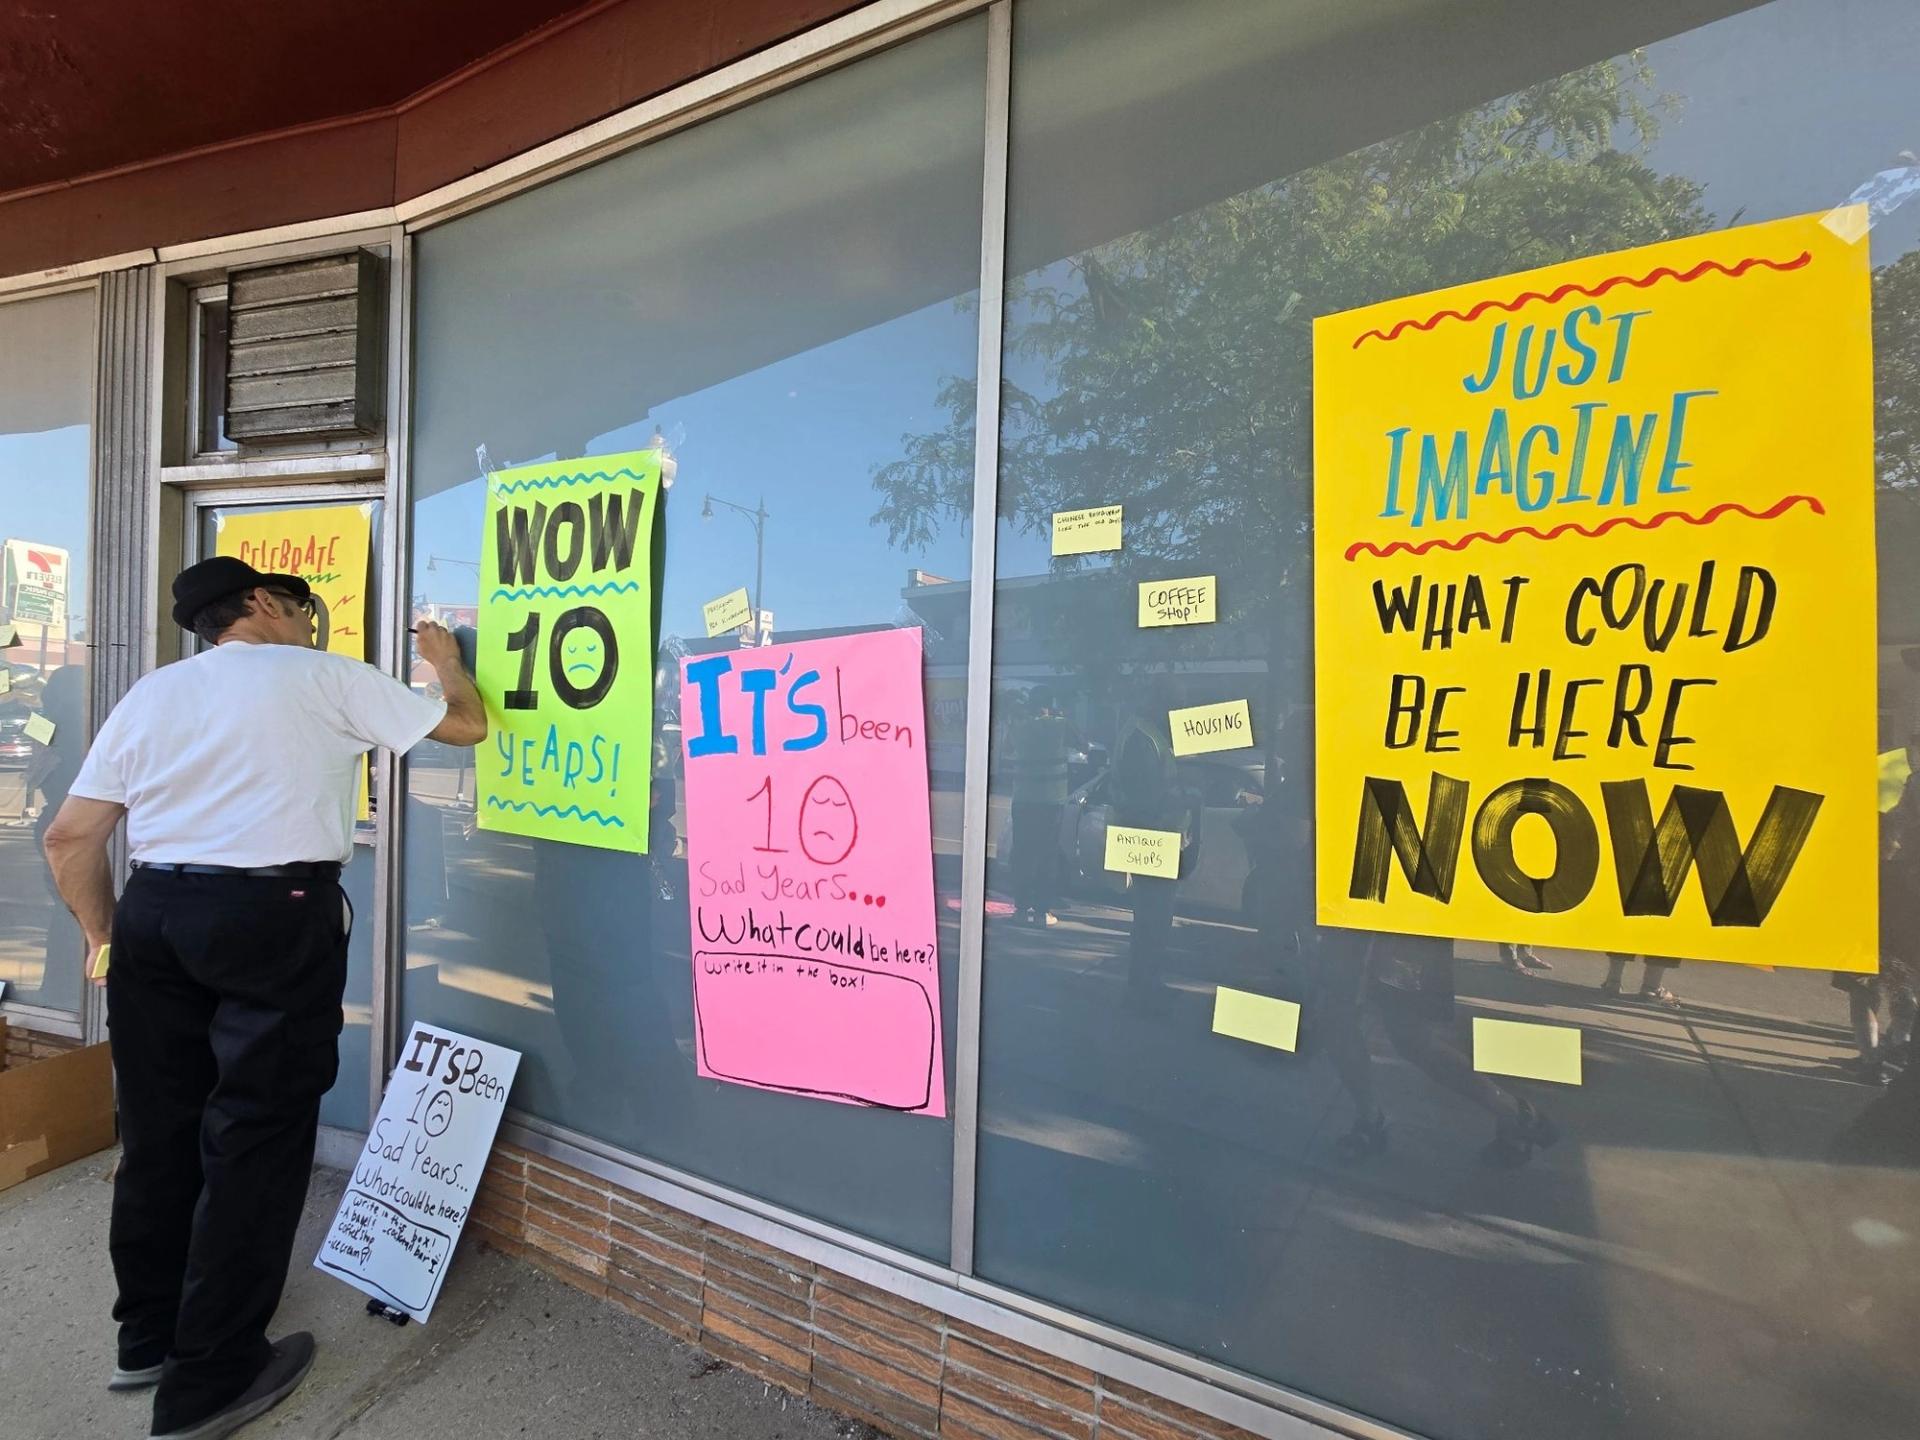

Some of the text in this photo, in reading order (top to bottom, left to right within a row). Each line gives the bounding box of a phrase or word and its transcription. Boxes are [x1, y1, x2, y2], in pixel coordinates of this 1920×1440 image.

[1462, 305, 1652, 400] JUST
[1378, 390, 1719, 528] IMAGINE
[240, 535, 340, 574] CELEBRATE
[496, 488, 645, 587] WOW
[1148, 586, 1207, 607] COFFEE
[1157, 606, 1199, 621] SHOP!
[1372, 559, 1777, 652] WHAT COULD
[504, 606, 619, 711] 10
[686, 652, 912, 759] IT'S been
[1184, 711, 1243, 738] HOUSING
[1384, 663, 1717, 770] BE HERE
[497, 724, 622, 797] YEARS!
[746, 774, 859, 866] 10
[1117, 833, 1163, 848] ANTIQUE
[1126, 852, 1163, 869] SHOPS
[1348, 770, 1825, 928] NOW
[699, 860, 745, 898] Sad
[869, 932, 889, 963] be
[895, 944, 936, 972] here?
[829, 970, 866, 991] box!
[404, 1031, 505, 1103] IT'S Been
[406, 1082, 453, 1137] 10
[368, 1117, 410, 1162] Sad
[438, 1200, 467, 1229] here?
